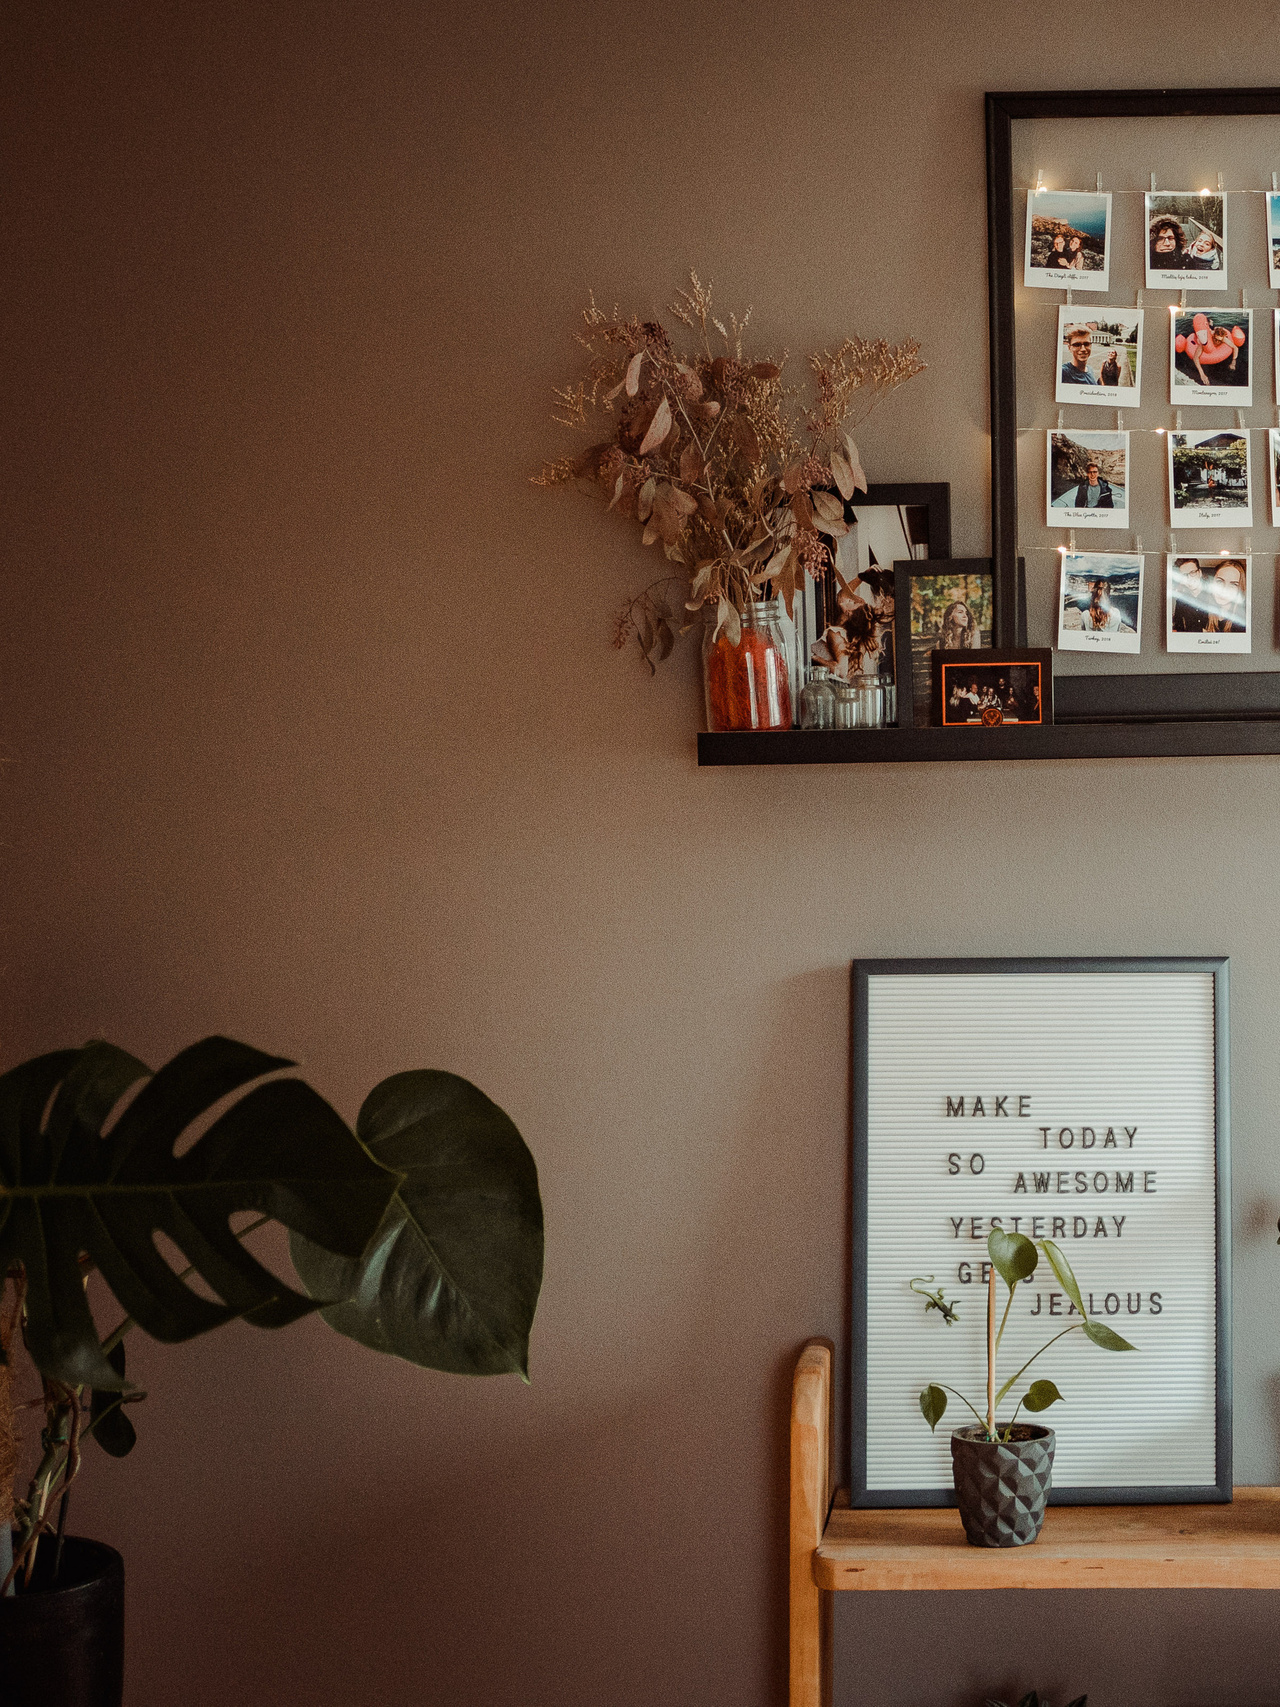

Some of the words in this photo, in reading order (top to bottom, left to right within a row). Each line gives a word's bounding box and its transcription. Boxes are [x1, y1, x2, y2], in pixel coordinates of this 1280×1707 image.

[946, 1095, 1032, 1117] MAKE
[1039, 1127, 1138, 1149] TODAY
[948, 1153, 985, 1175] SO
[1013, 1171, 1158, 1193] AWESOME
